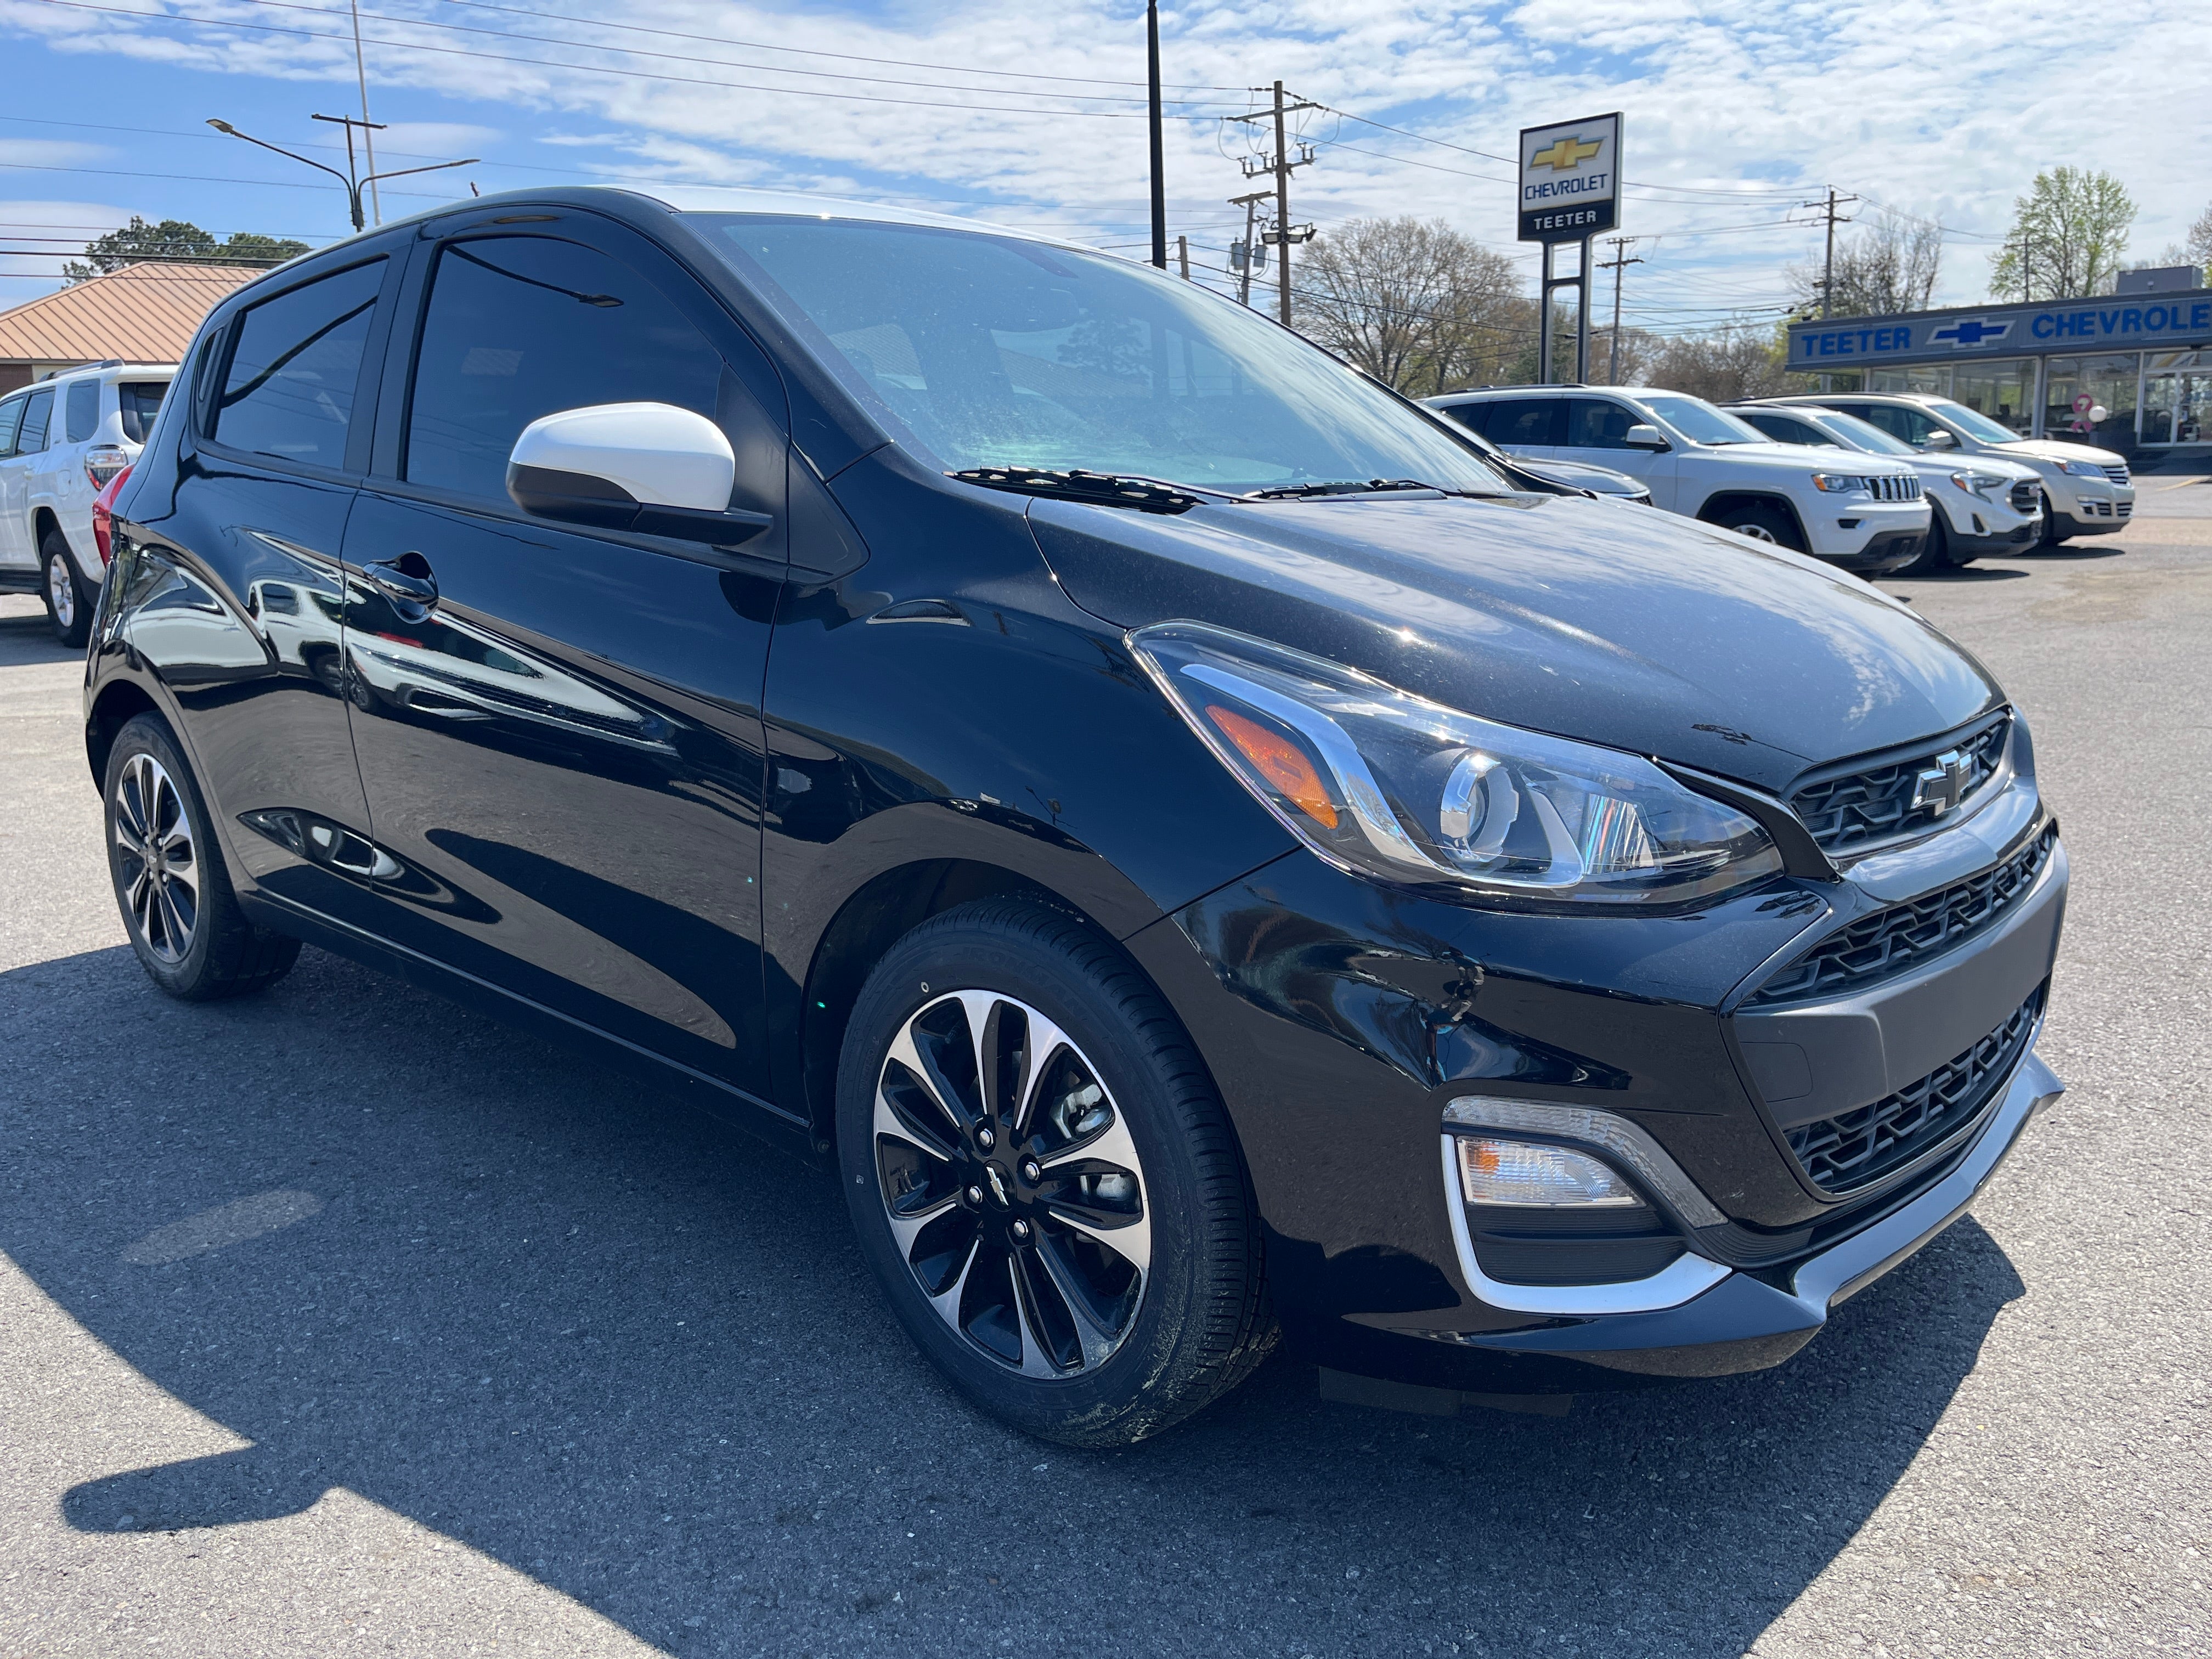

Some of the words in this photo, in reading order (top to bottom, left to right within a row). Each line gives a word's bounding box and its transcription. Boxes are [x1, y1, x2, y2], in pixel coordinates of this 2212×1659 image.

[1525, 173, 1608, 200] CHEVROLET
[1534, 210, 1596, 230] TEETER
[1801, 326, 1911, 356] TEETER
